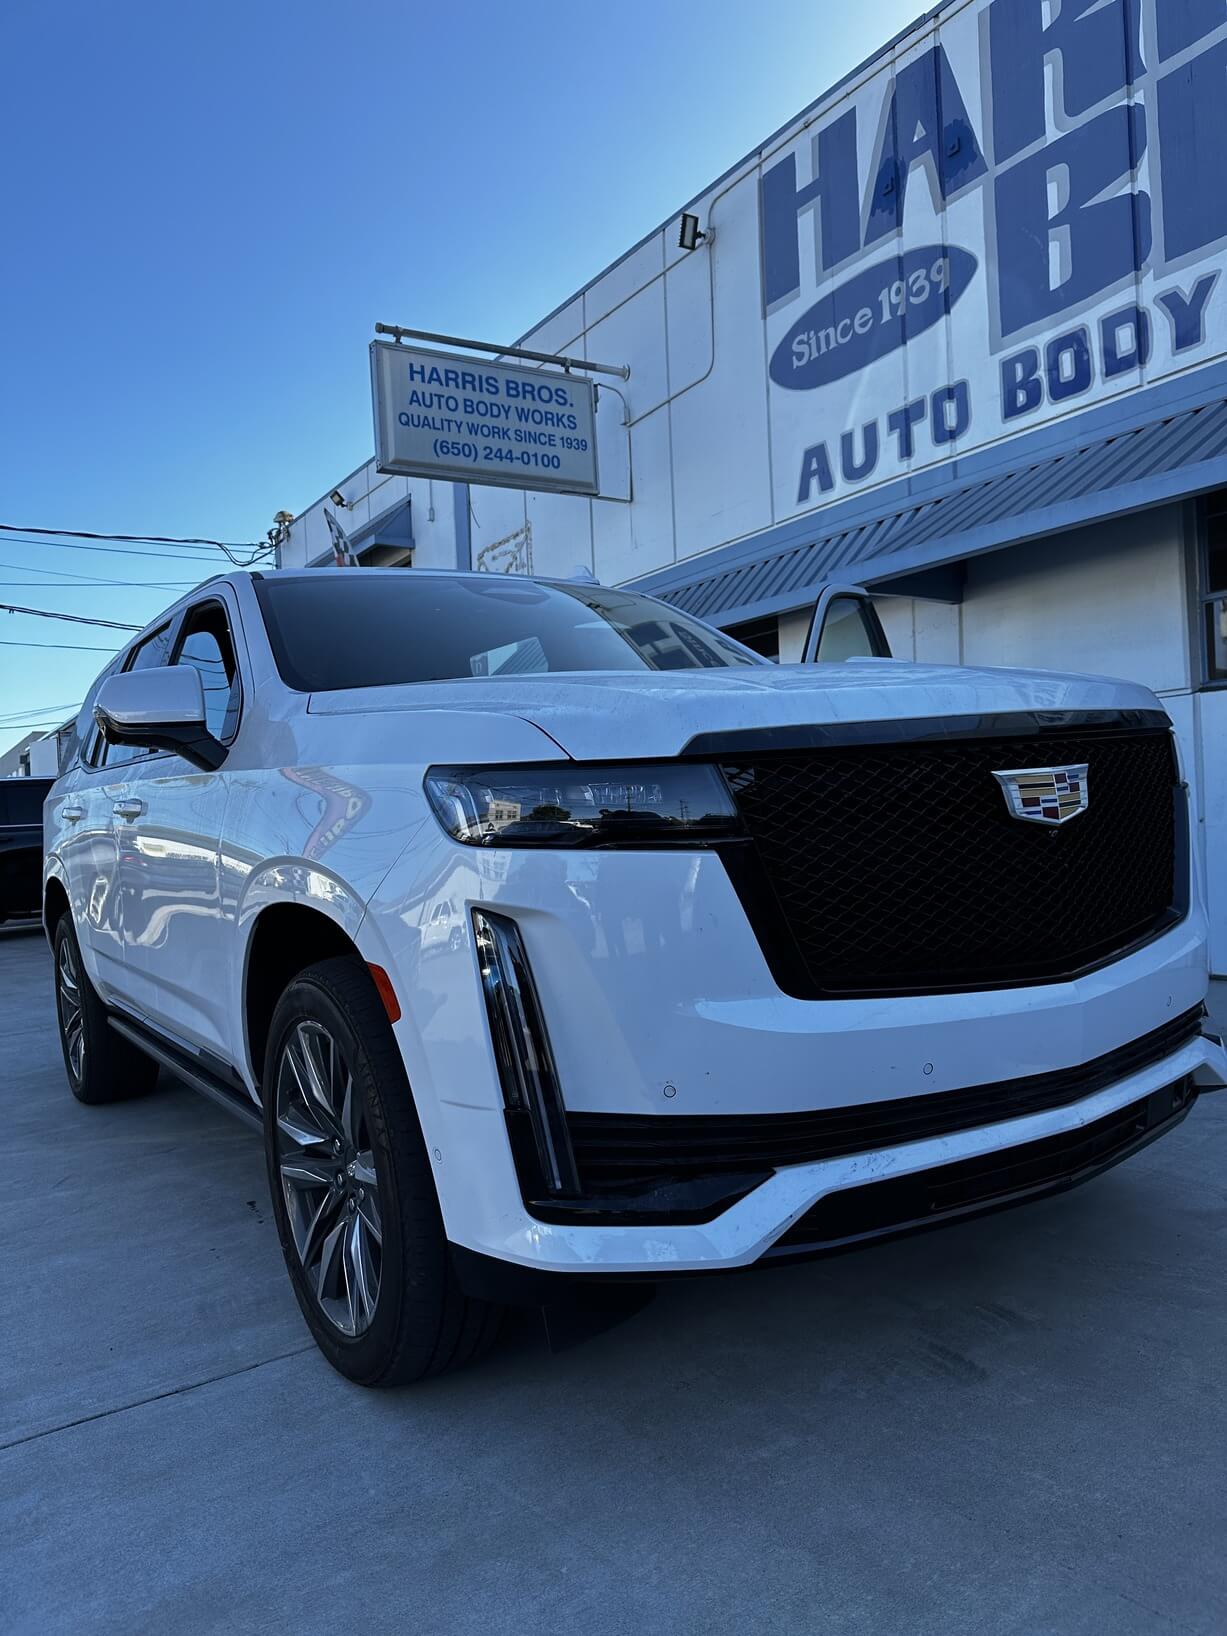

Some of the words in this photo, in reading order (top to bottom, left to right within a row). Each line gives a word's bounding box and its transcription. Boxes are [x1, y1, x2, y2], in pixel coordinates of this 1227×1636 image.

[760, 0, 1227, 313] HAR
[791, 304, 874, 369] Since
[878, 257, 950, 323] 1939
[408, 362, 500, 396] HARRIS
[505, 379, 575, 408] BROS.
[797, 378, 973, 505] AUTO
[1000, 268, 1223, 424] BODY
[398, 412, 463, 433] QUALITY
[466, 421, 512, 441] WORK
[514, 428, 556, 447] SINCE
[559, 436, 588, 451] 1939
[408, 389, 459, 412] AUTO
[463, 398, 511, 420] BODY
[515, 406, 578, 430] WORKS
[433, 437, 479, 463] (650)
[483, 445, 561, 470] 244-0100
